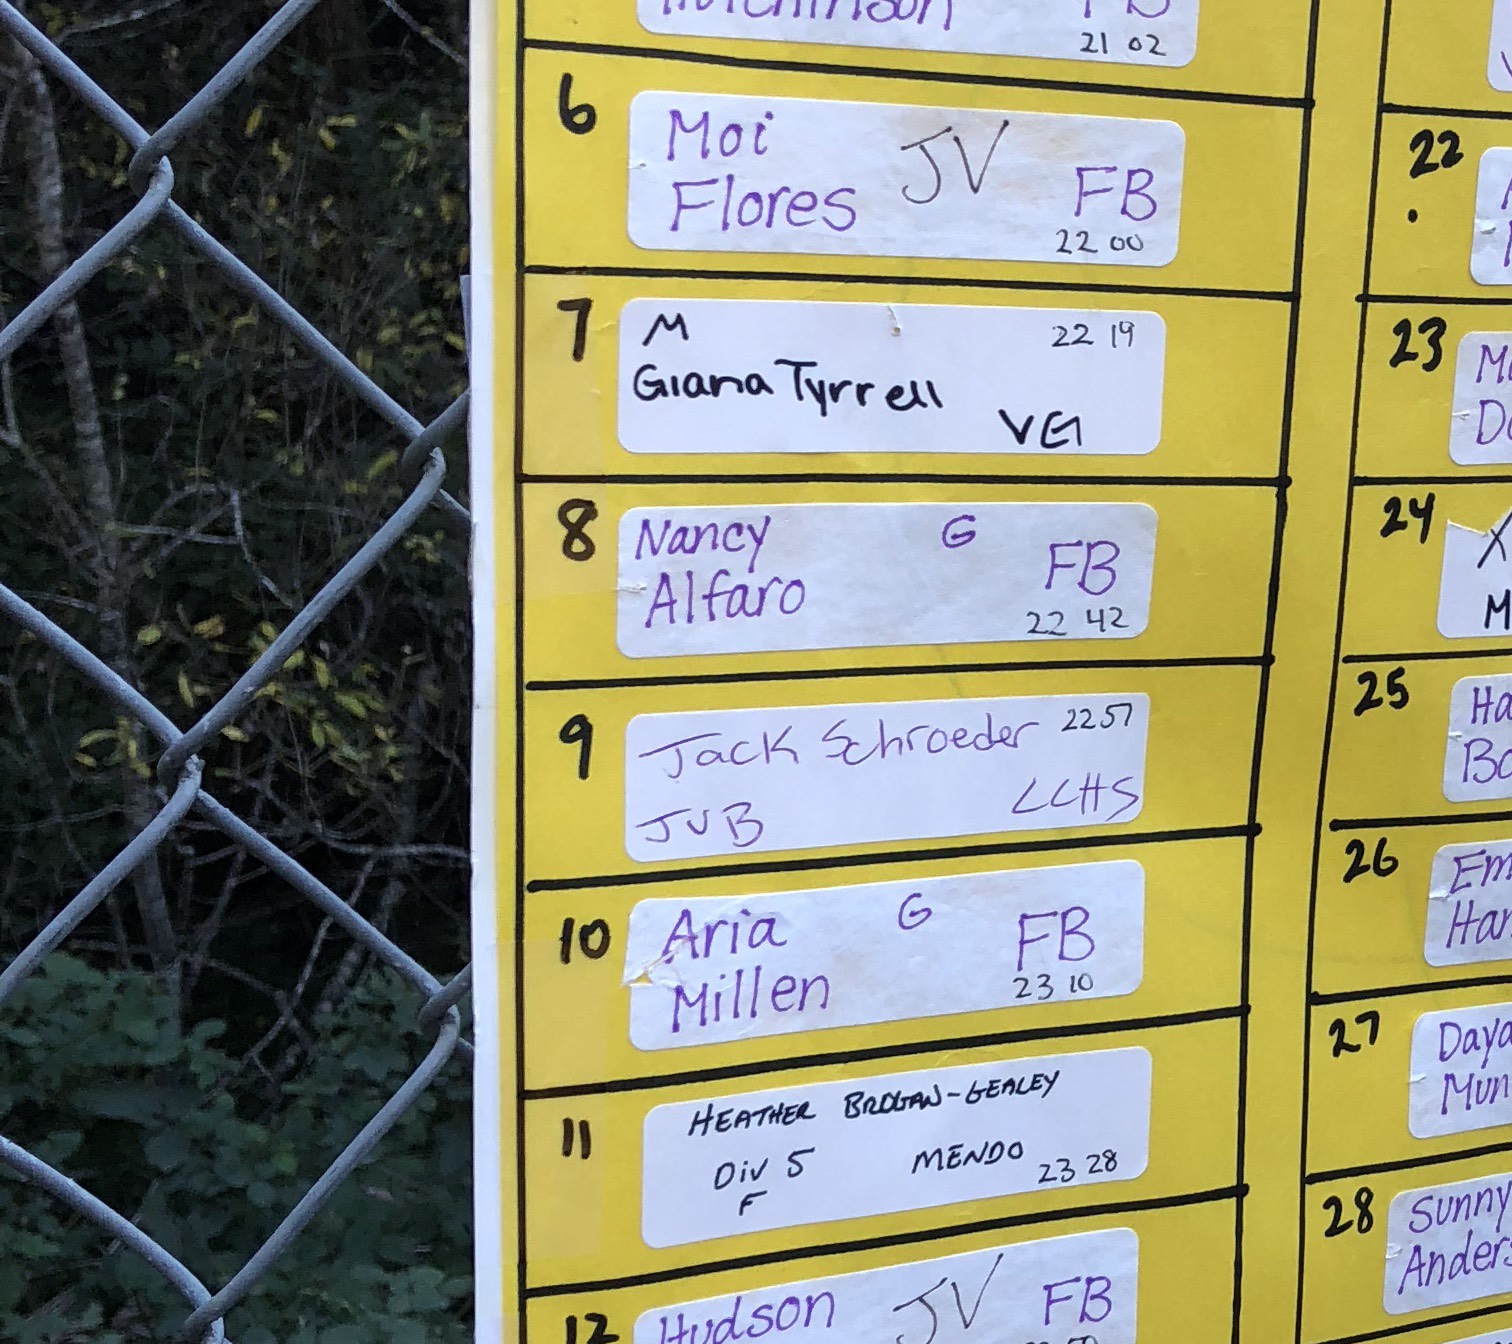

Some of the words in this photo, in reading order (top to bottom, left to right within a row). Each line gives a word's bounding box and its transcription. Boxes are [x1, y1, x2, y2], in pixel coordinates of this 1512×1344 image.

[558, 73, 597, 135] 6
[667, 109, 774, 161] Moi
[1409, 129, 1464, 179] 22
[670, 174, 856, 232] Flores
[557, 297, 594, 362] 7
[1389, 317, 1447, 372] 23
[557, 498, 598, 562] 8
[635, 515, 771, 573] Nancy
[645, 569, 805, 628] Alfaro
[1354, 666, 1409, 717] 25
[559, 714, 594, 780] 9
[822, 713, 1039, 765] Schroeder
[559, 917, 611, 965] 10
[661, 909, 787, 964] Aria
[672, 965, 829, 1033] Millen
[1017, 906, 1095, 972] FB
[1329, 1010, 1380, 1058] 27
[688, 1101, 816, 1136] HEATHER
[1322, 1187, 1374, 1237] 28
[1409, 1180, 1512, 1233] Sunny
